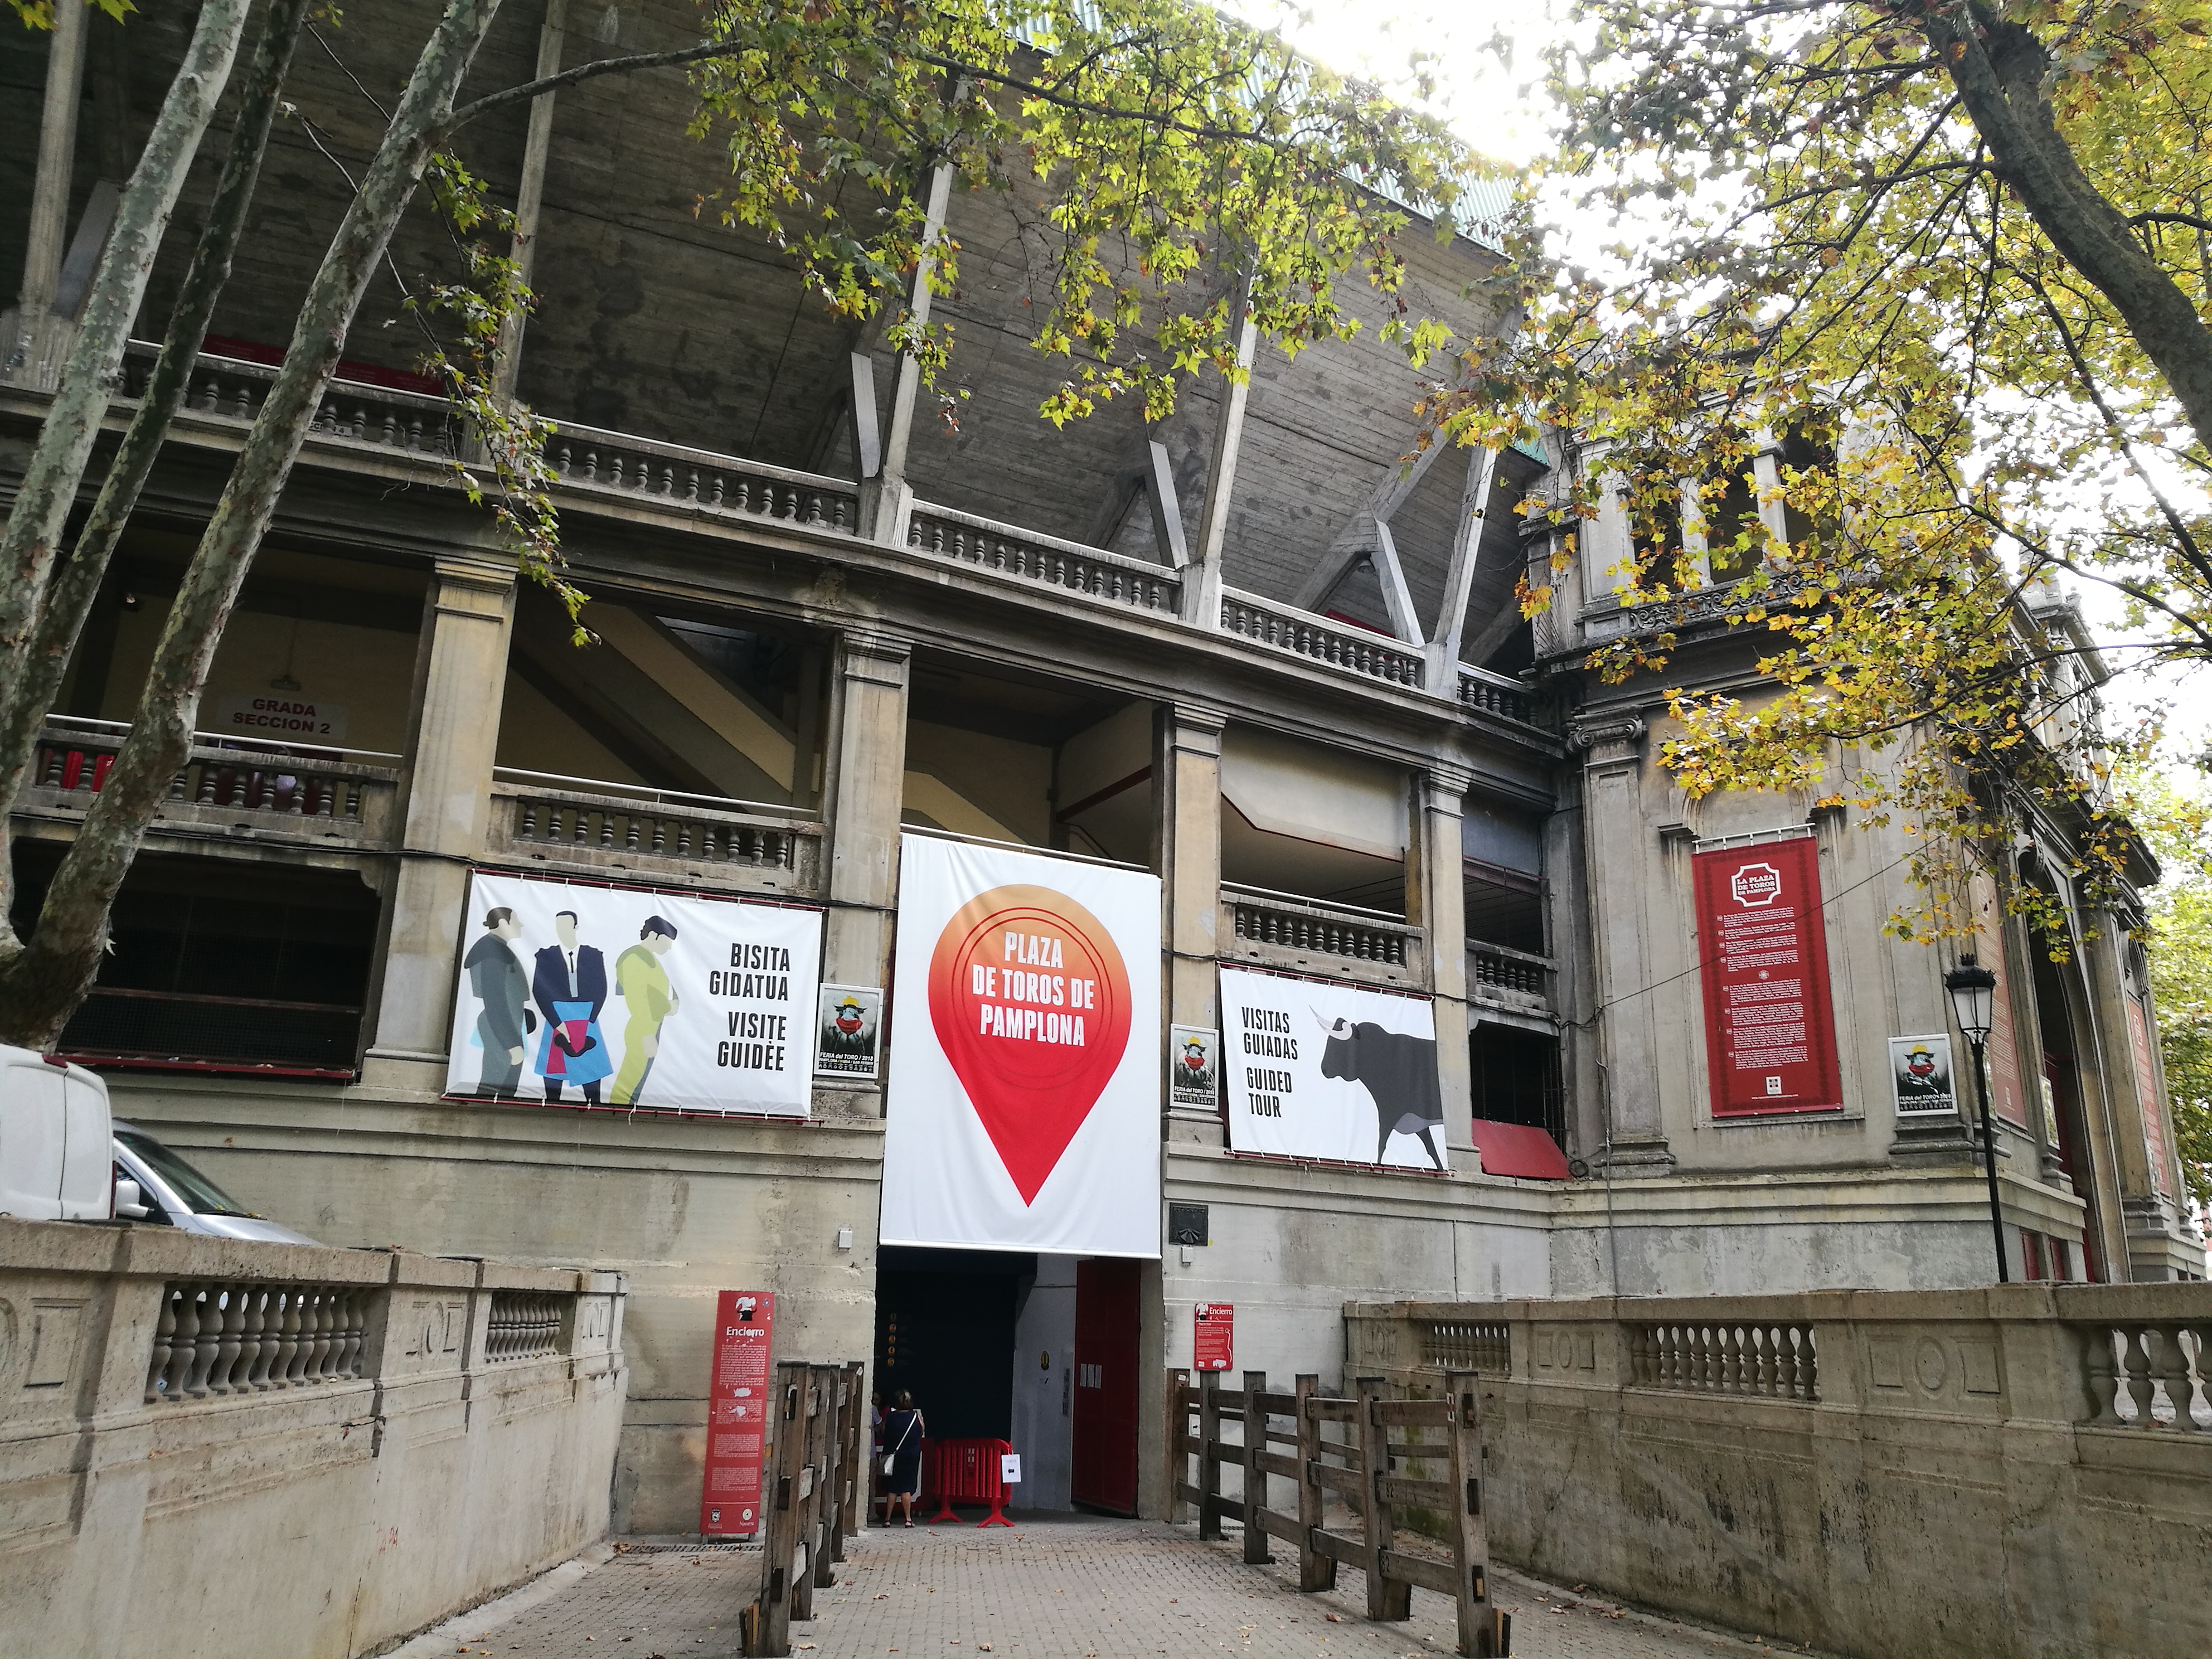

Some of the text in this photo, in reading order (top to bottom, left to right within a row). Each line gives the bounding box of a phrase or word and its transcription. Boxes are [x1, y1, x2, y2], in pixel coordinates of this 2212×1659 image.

[252, 698, 316, 717] GRADA
[232, 712, 331, 734] SECCION 2
[1748, 874, 1774, 883] PLAZA
[730, 943, 790, 971] BISITA
[1005, 932, 1064, 968] PLAZA
[709, 970, 788, 1001] GIDATUA
[972, 964, 1094, 1009] DE TOROS DE
[728, 1011, 787, 1041] VISITE
[980, 1003, 1085, 1046] PAMPLONA
[1241, 1007, 1289, 1034] VISITAS
[1244, 1032, 1298, 1060] GUIADAS
[1246, 1067, 1292, 1093] GUIDED
[1248, 1093, 1282, 1118] TOUR
[1209, 1307, 1233, 1315] Encierro
